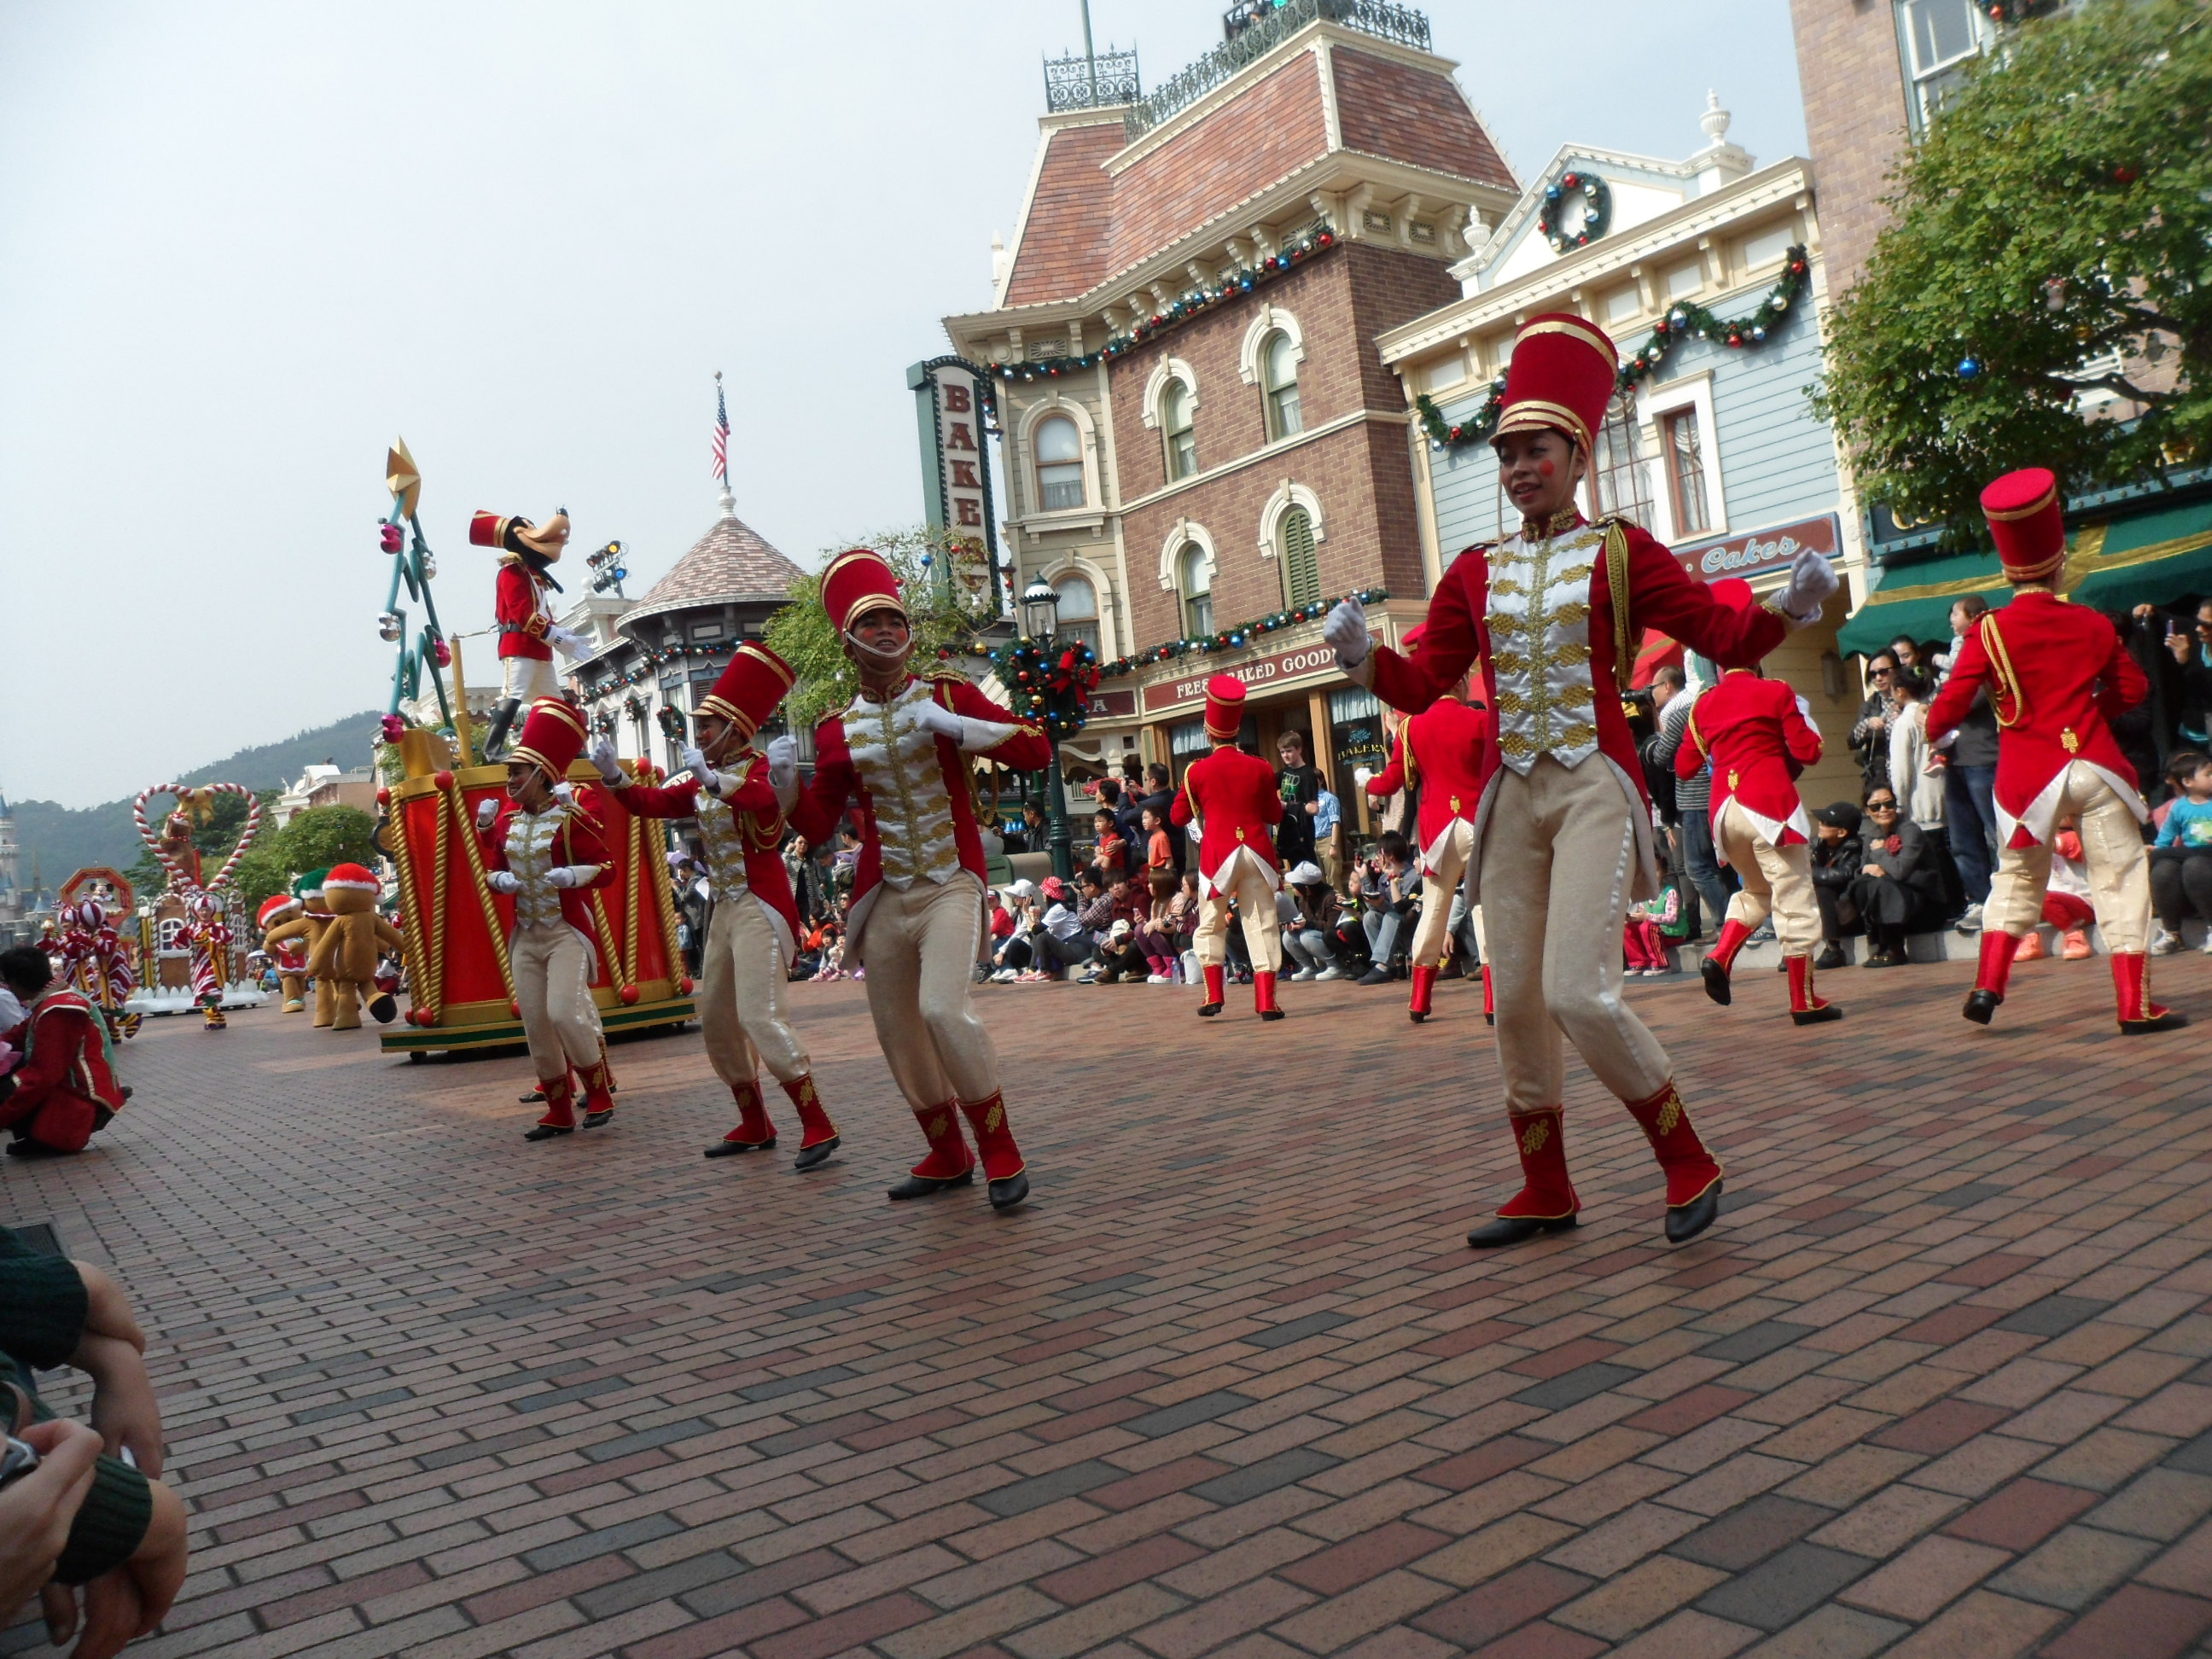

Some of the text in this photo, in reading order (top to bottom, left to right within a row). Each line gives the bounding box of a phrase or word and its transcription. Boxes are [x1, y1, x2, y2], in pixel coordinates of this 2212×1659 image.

[1701, 536, 1801, 573] Cakes
[1177, 678, 1211, 699] FRES
[1282, 648, 1337, 672] GOOD
[1337, 744, 1384, 761] BAKERY
